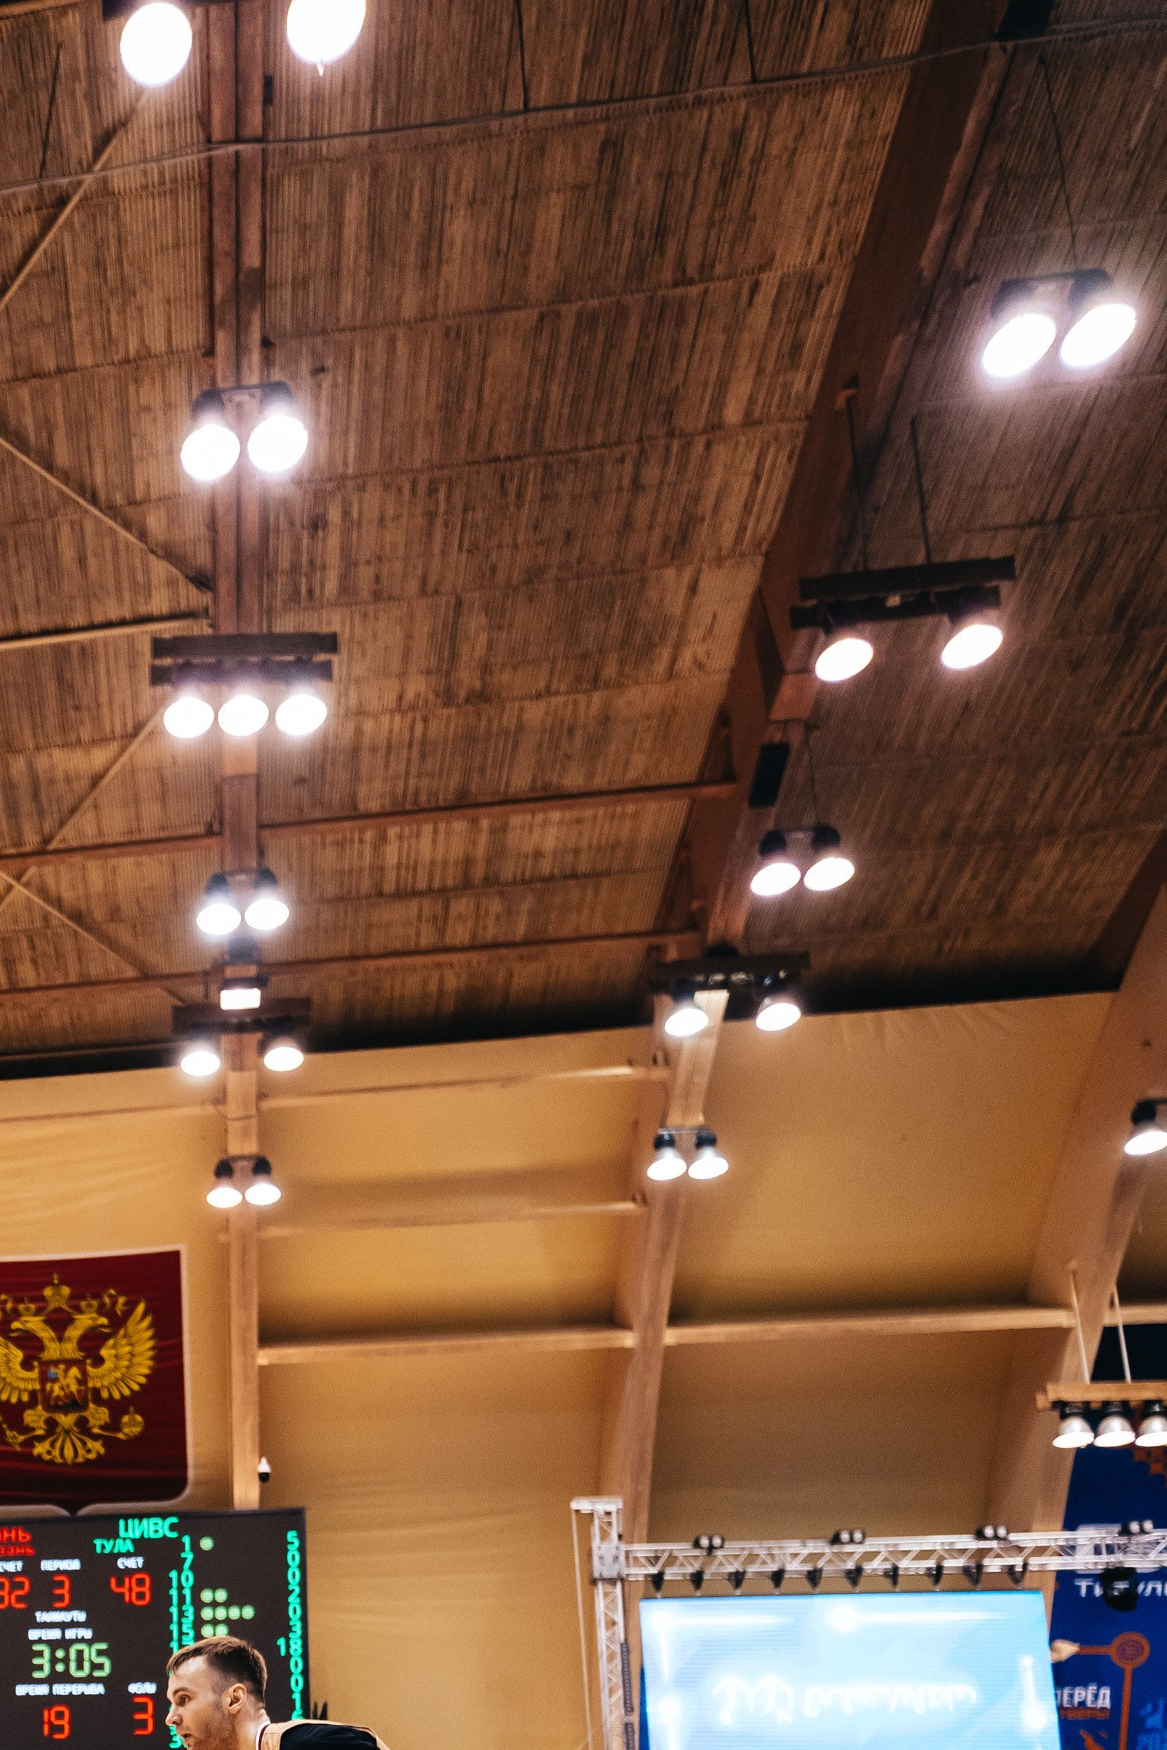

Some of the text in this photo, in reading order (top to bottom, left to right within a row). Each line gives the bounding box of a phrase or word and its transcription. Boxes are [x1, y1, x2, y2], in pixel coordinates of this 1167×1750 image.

[119, 1517, 179, 1539] ЦИВС
[93, 1538, 135, 1554] ТУЛА
[52, 1573, 71, 1608] 3
[109, 1571, 151, 1606] 48
[31, 1642, 112, 1678] 3:05
[1058, 1684, 1111, 1709] ЕРЁД
[42, 1704, 70, 1740] 19
[132, 1696, 155, 1735] 3
